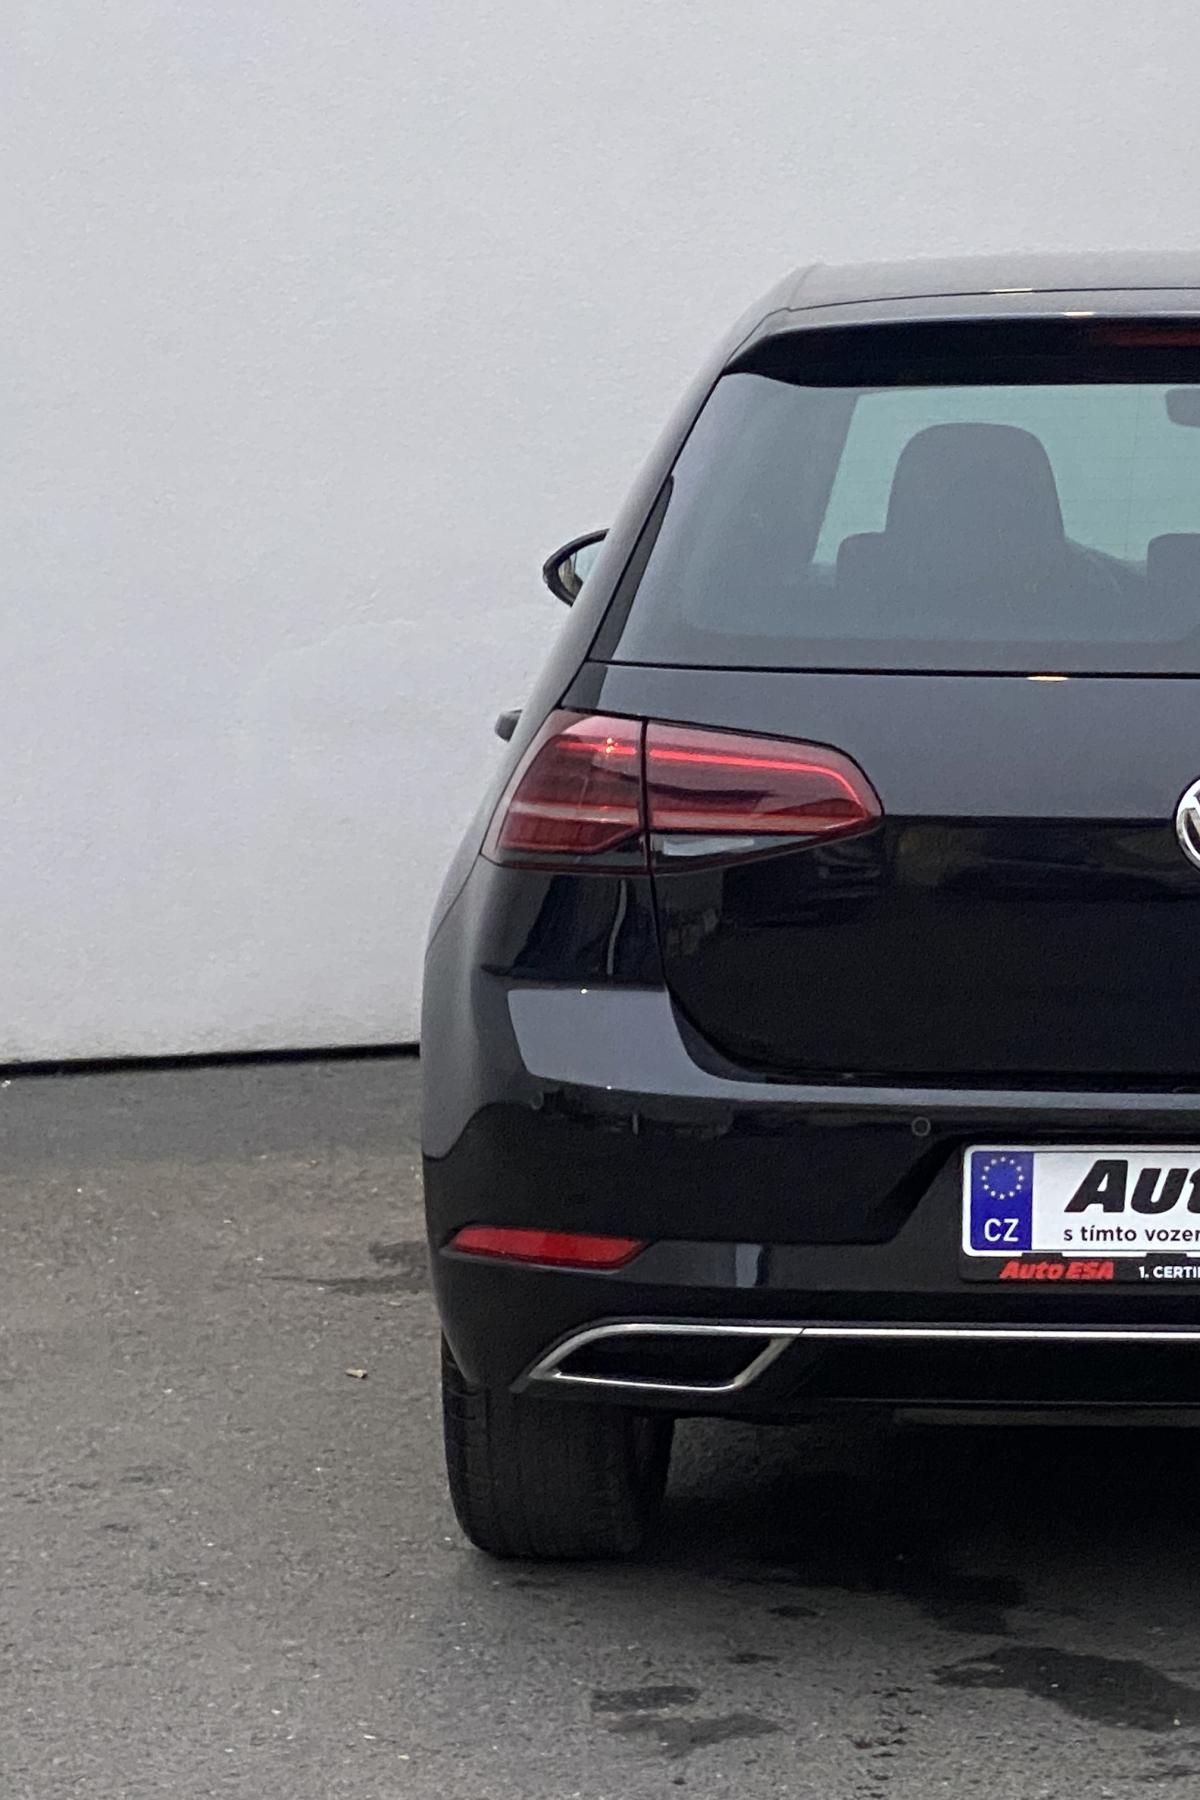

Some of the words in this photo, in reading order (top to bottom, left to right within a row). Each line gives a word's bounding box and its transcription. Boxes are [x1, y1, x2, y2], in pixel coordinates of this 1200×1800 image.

[983, 1218, 1019, 1242] CZ
[1063, 1228, 1073, 1243] s
[1080, 1224, 1137, 1243] tímto
[1000, 1261, 1062, 1280] Auto
[1064, 1262, 1114, 1280] ESA
[1138, 1267, 1150, 1279] 1.
